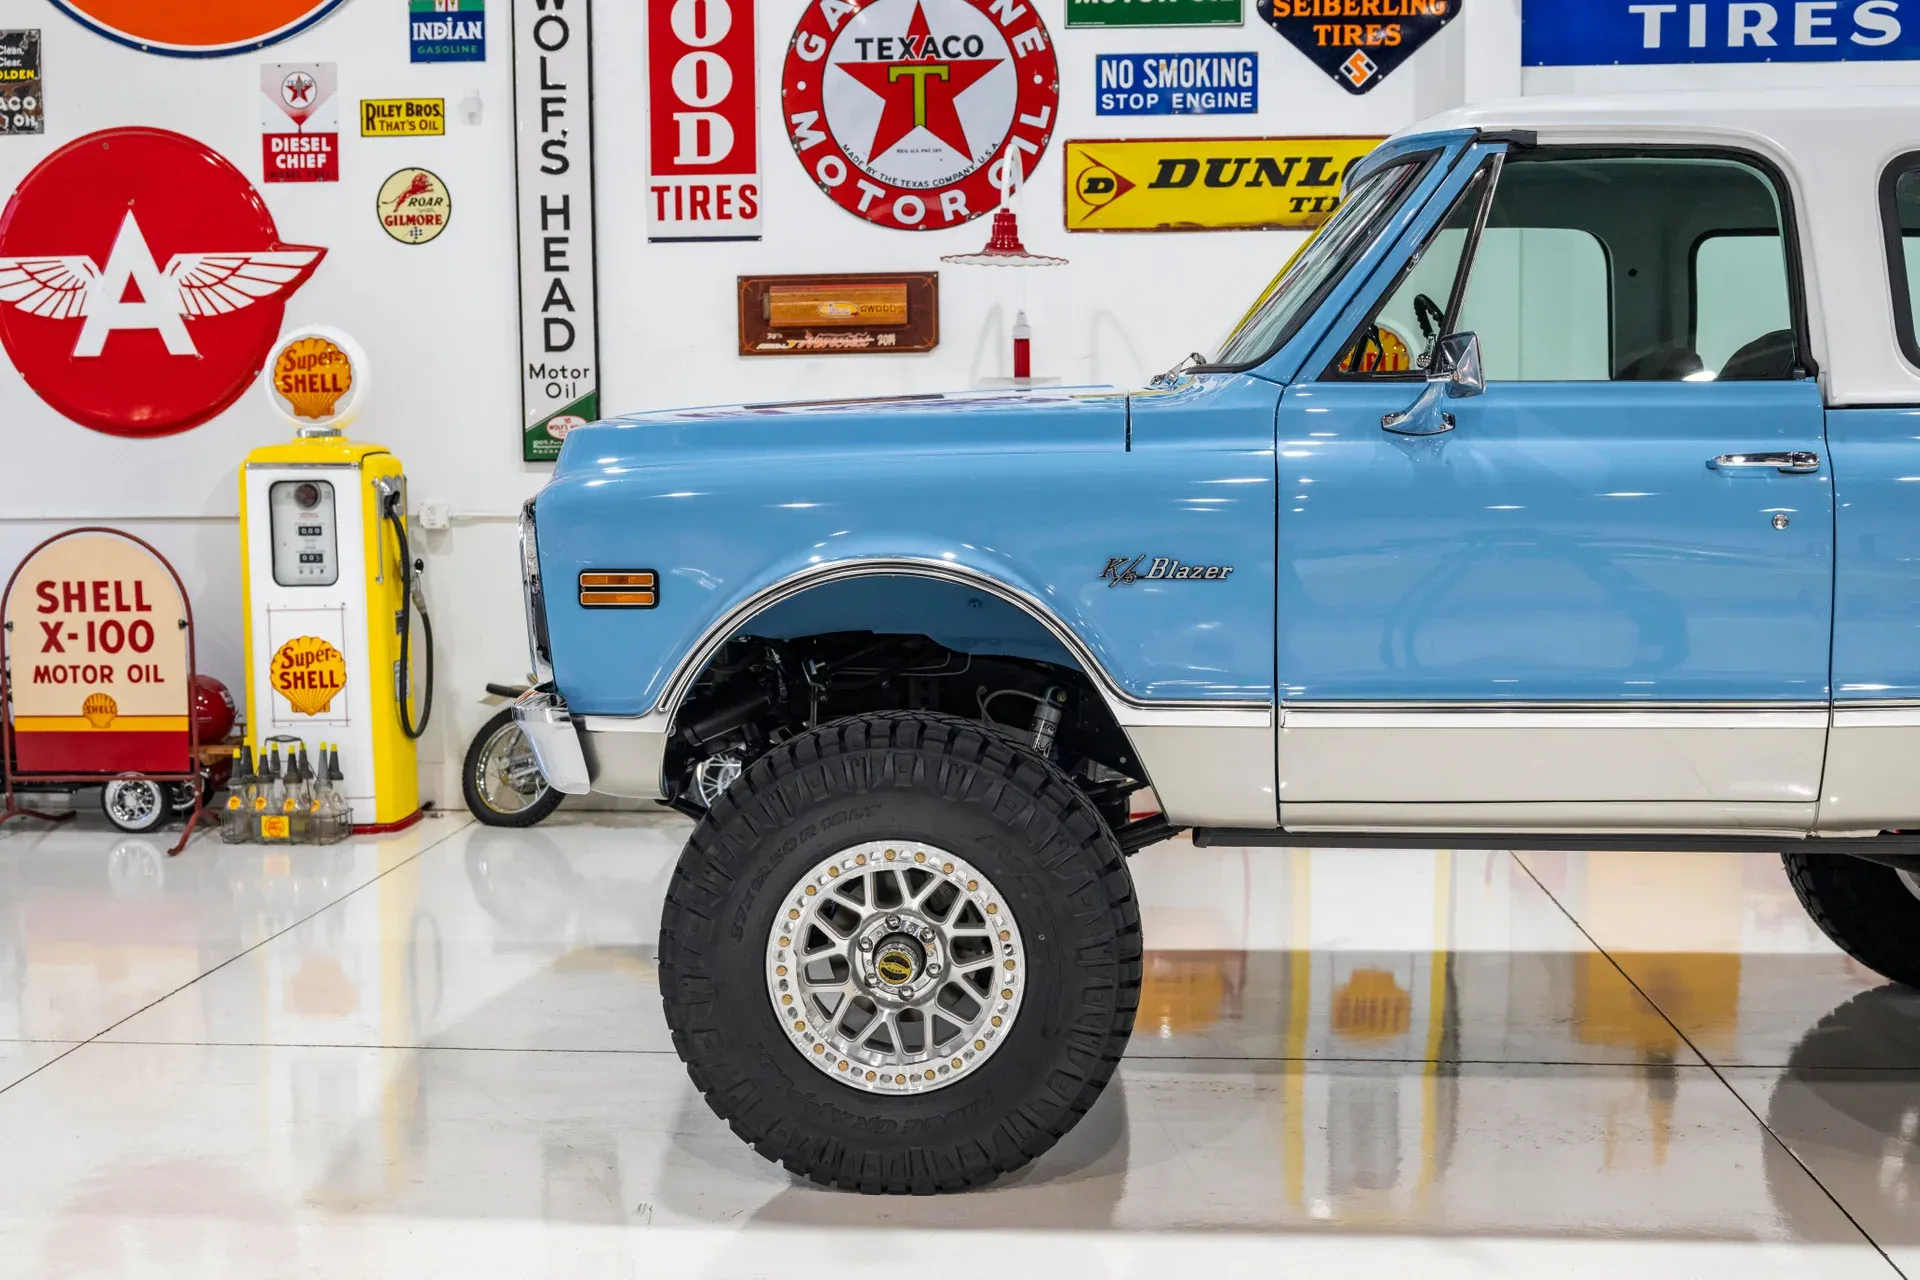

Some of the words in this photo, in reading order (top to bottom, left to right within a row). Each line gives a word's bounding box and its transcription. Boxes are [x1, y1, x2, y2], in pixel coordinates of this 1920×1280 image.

[1273, 0, 1448, 18] SEIBERLING
[412, 17, 483, 41] INDIAN
[1313, 24, 1402, 47] TIRES
[1628, 0, 1902, 49] TIRES
[417, 45, 478, 54] GASOLINE
[855, 35, 984, 60] TEXACO
[1101, 59, 1134, 89] NO
[1143, 57, 1253, 89] SMOKING
[533, 0, 570, 176] OLF'S
[888, 64, 949, 128] T
[1101, 93, 1159, 109] STOP
[1172, 92, 1253, 108] ENGINE
[365, 102, 402, 131] RILEY
[379, 120, 416, 131] THAT'S
[419, 119, 439, 131] OIL
[271, 137, 332, 153] DIESEL
[276, 154, 327, 169] CHIEF
[791, 110, 971, 225] MOTOR
[841, 143, 865, 167] MADE
[865, 166, 877, 176] BY
[879, 173, 898, 186] THE
[901, 180, 930, 188] TEXAS
[1147, 156, 1354, 190] DUNL
[1083, 177, 1115, 194] D
[408, 197, 443, 207] ROAR
[651, 184, 758, 222] TIRES
[384, 214, 443, 227] GILMORE
[541, 194, 576, 353] HEAD
[281, 373, 343, 393] SHELL
[529, 363, 590, 380] Motor
[546, 382, 576, 399] Oil
[1145, 557, 1234, 580] Blazer
[36, 580, 153, 614] SHELL
[39, 619, 155, 654] X-100
[33, 665, 114, 684] MOTOR
[127, 664, 165, 684] OIL
[279, 670, 340, 690] SHELL
[86, 705, 115, 715] SHELL
